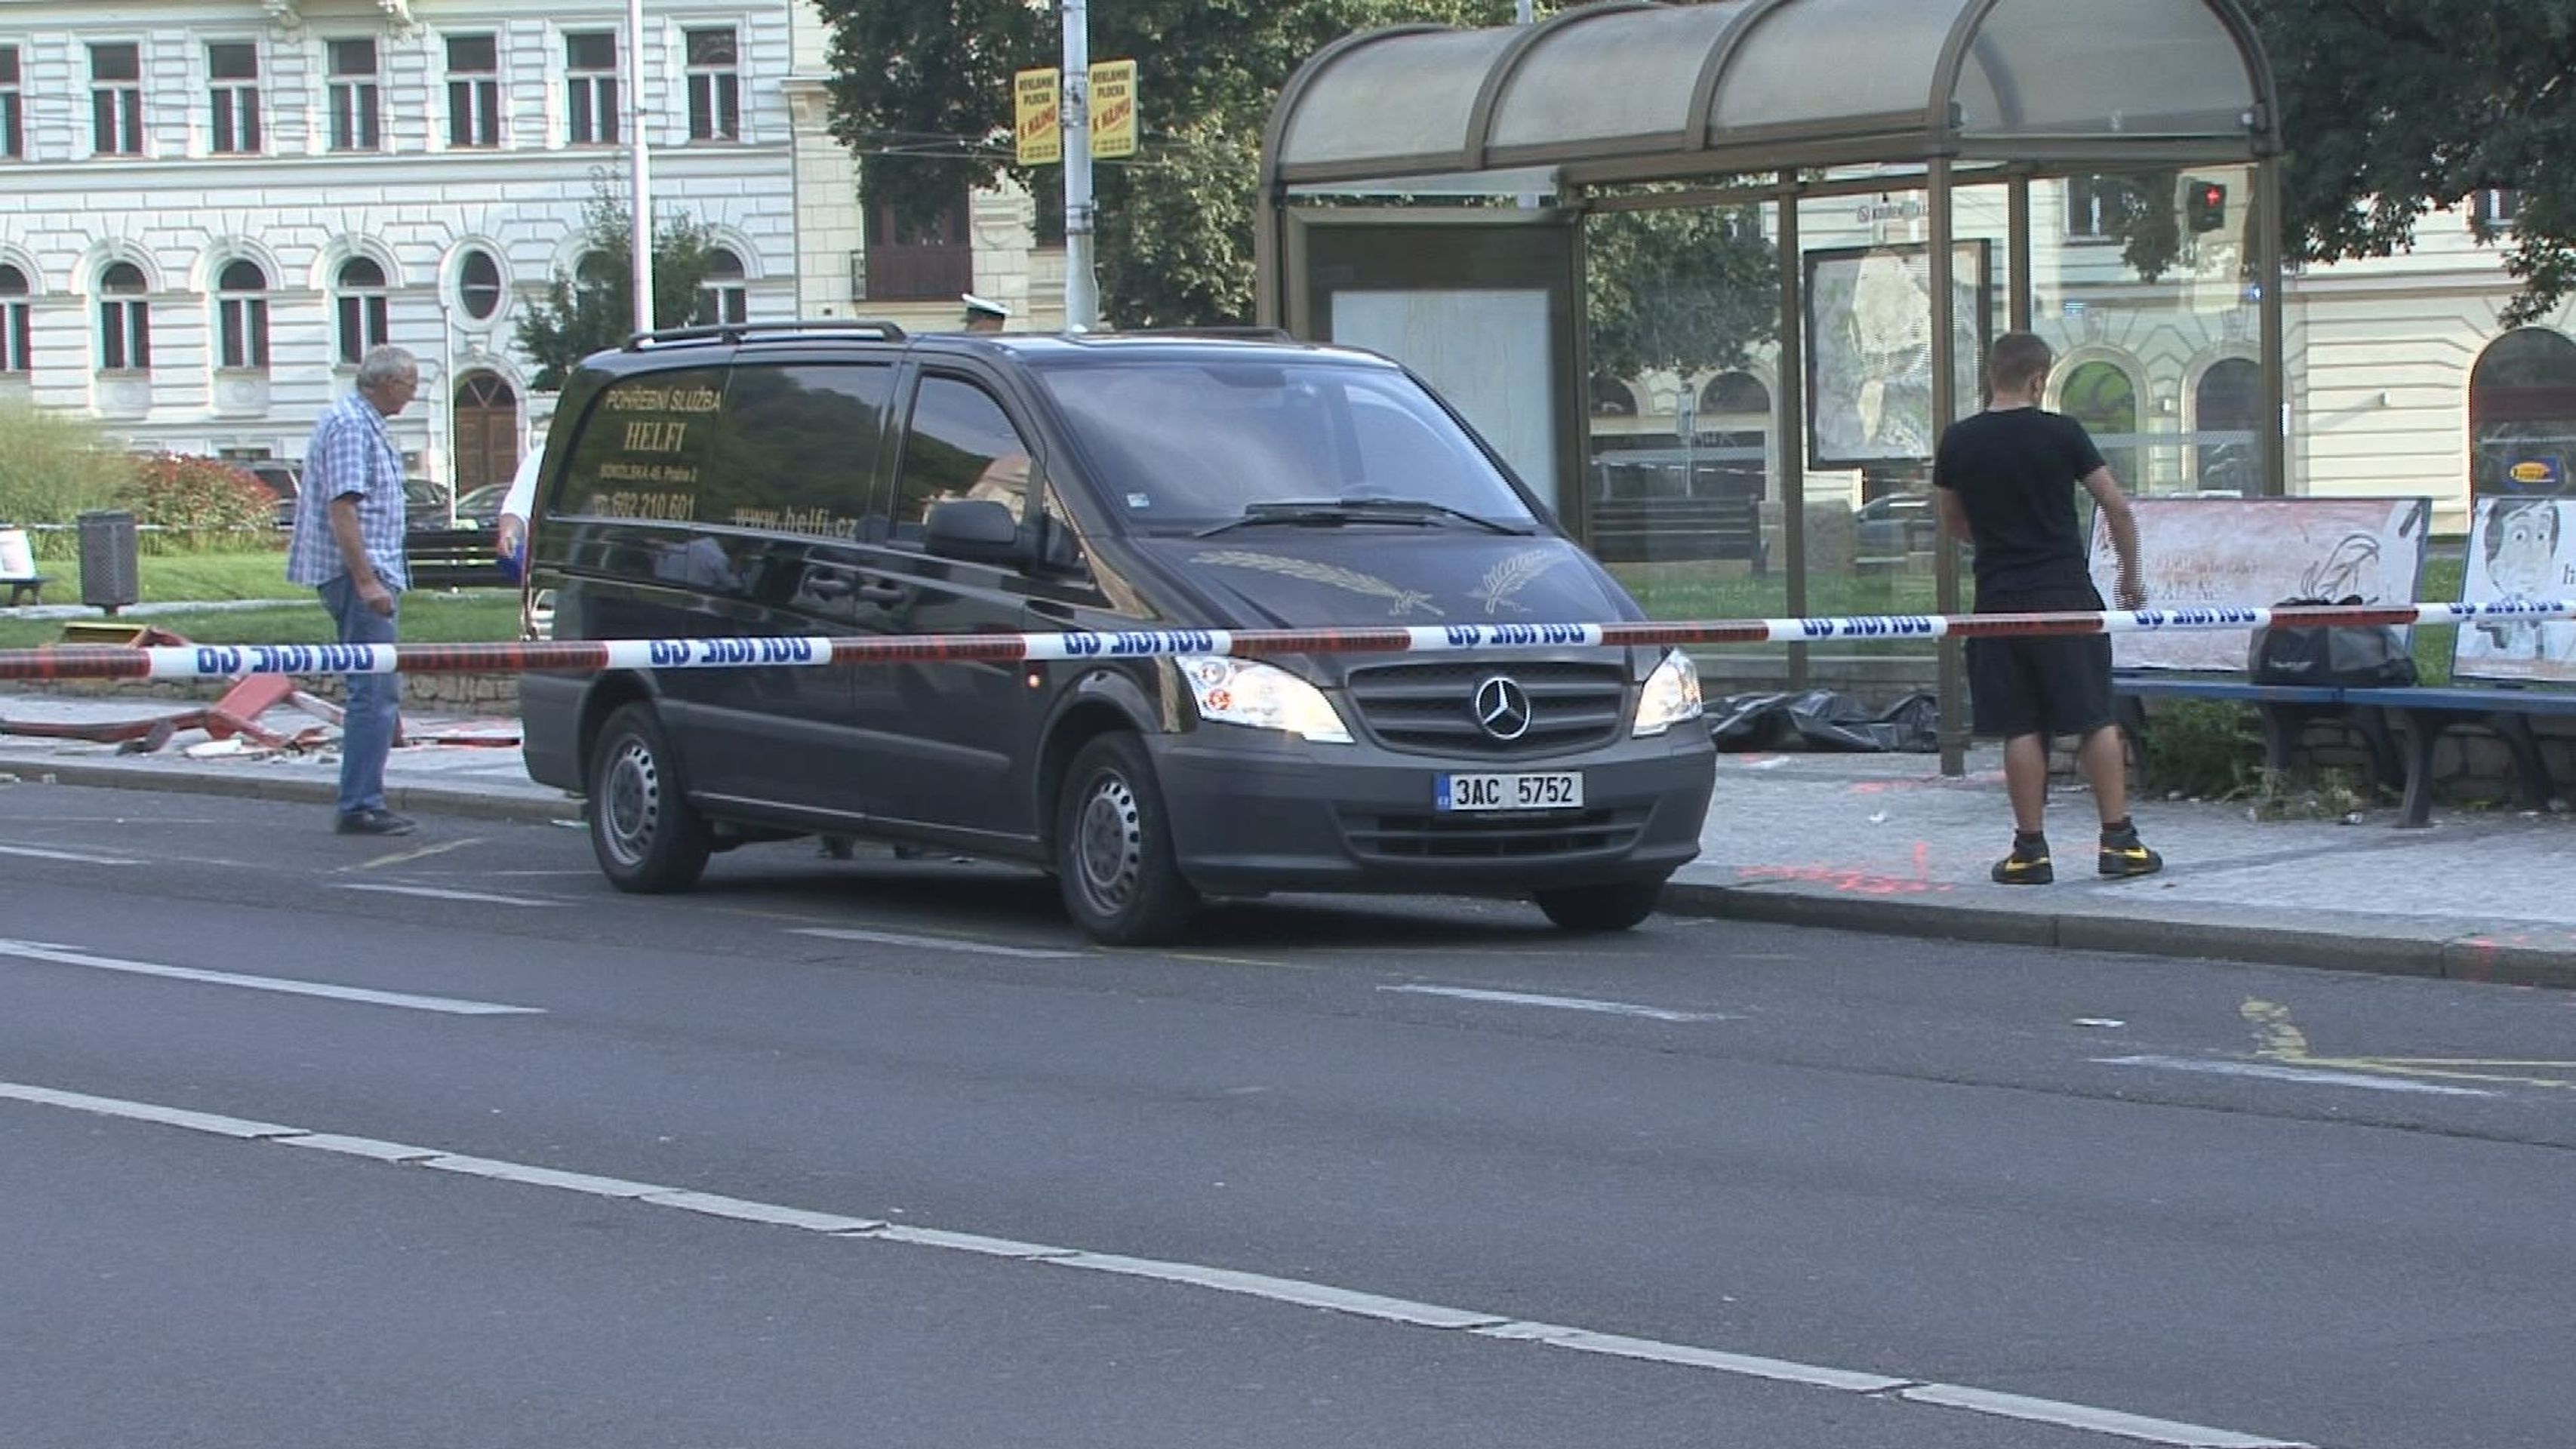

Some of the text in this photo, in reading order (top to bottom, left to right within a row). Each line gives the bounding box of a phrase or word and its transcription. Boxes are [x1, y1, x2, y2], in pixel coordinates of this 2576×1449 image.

[669, 386, 721, 412] SLUŽBA
[624, 422, 688, 451] HELFI
[734, 505, 859, 540] www.helfi.cz
[1456, 777, 1574, 805] 3AC 5752
